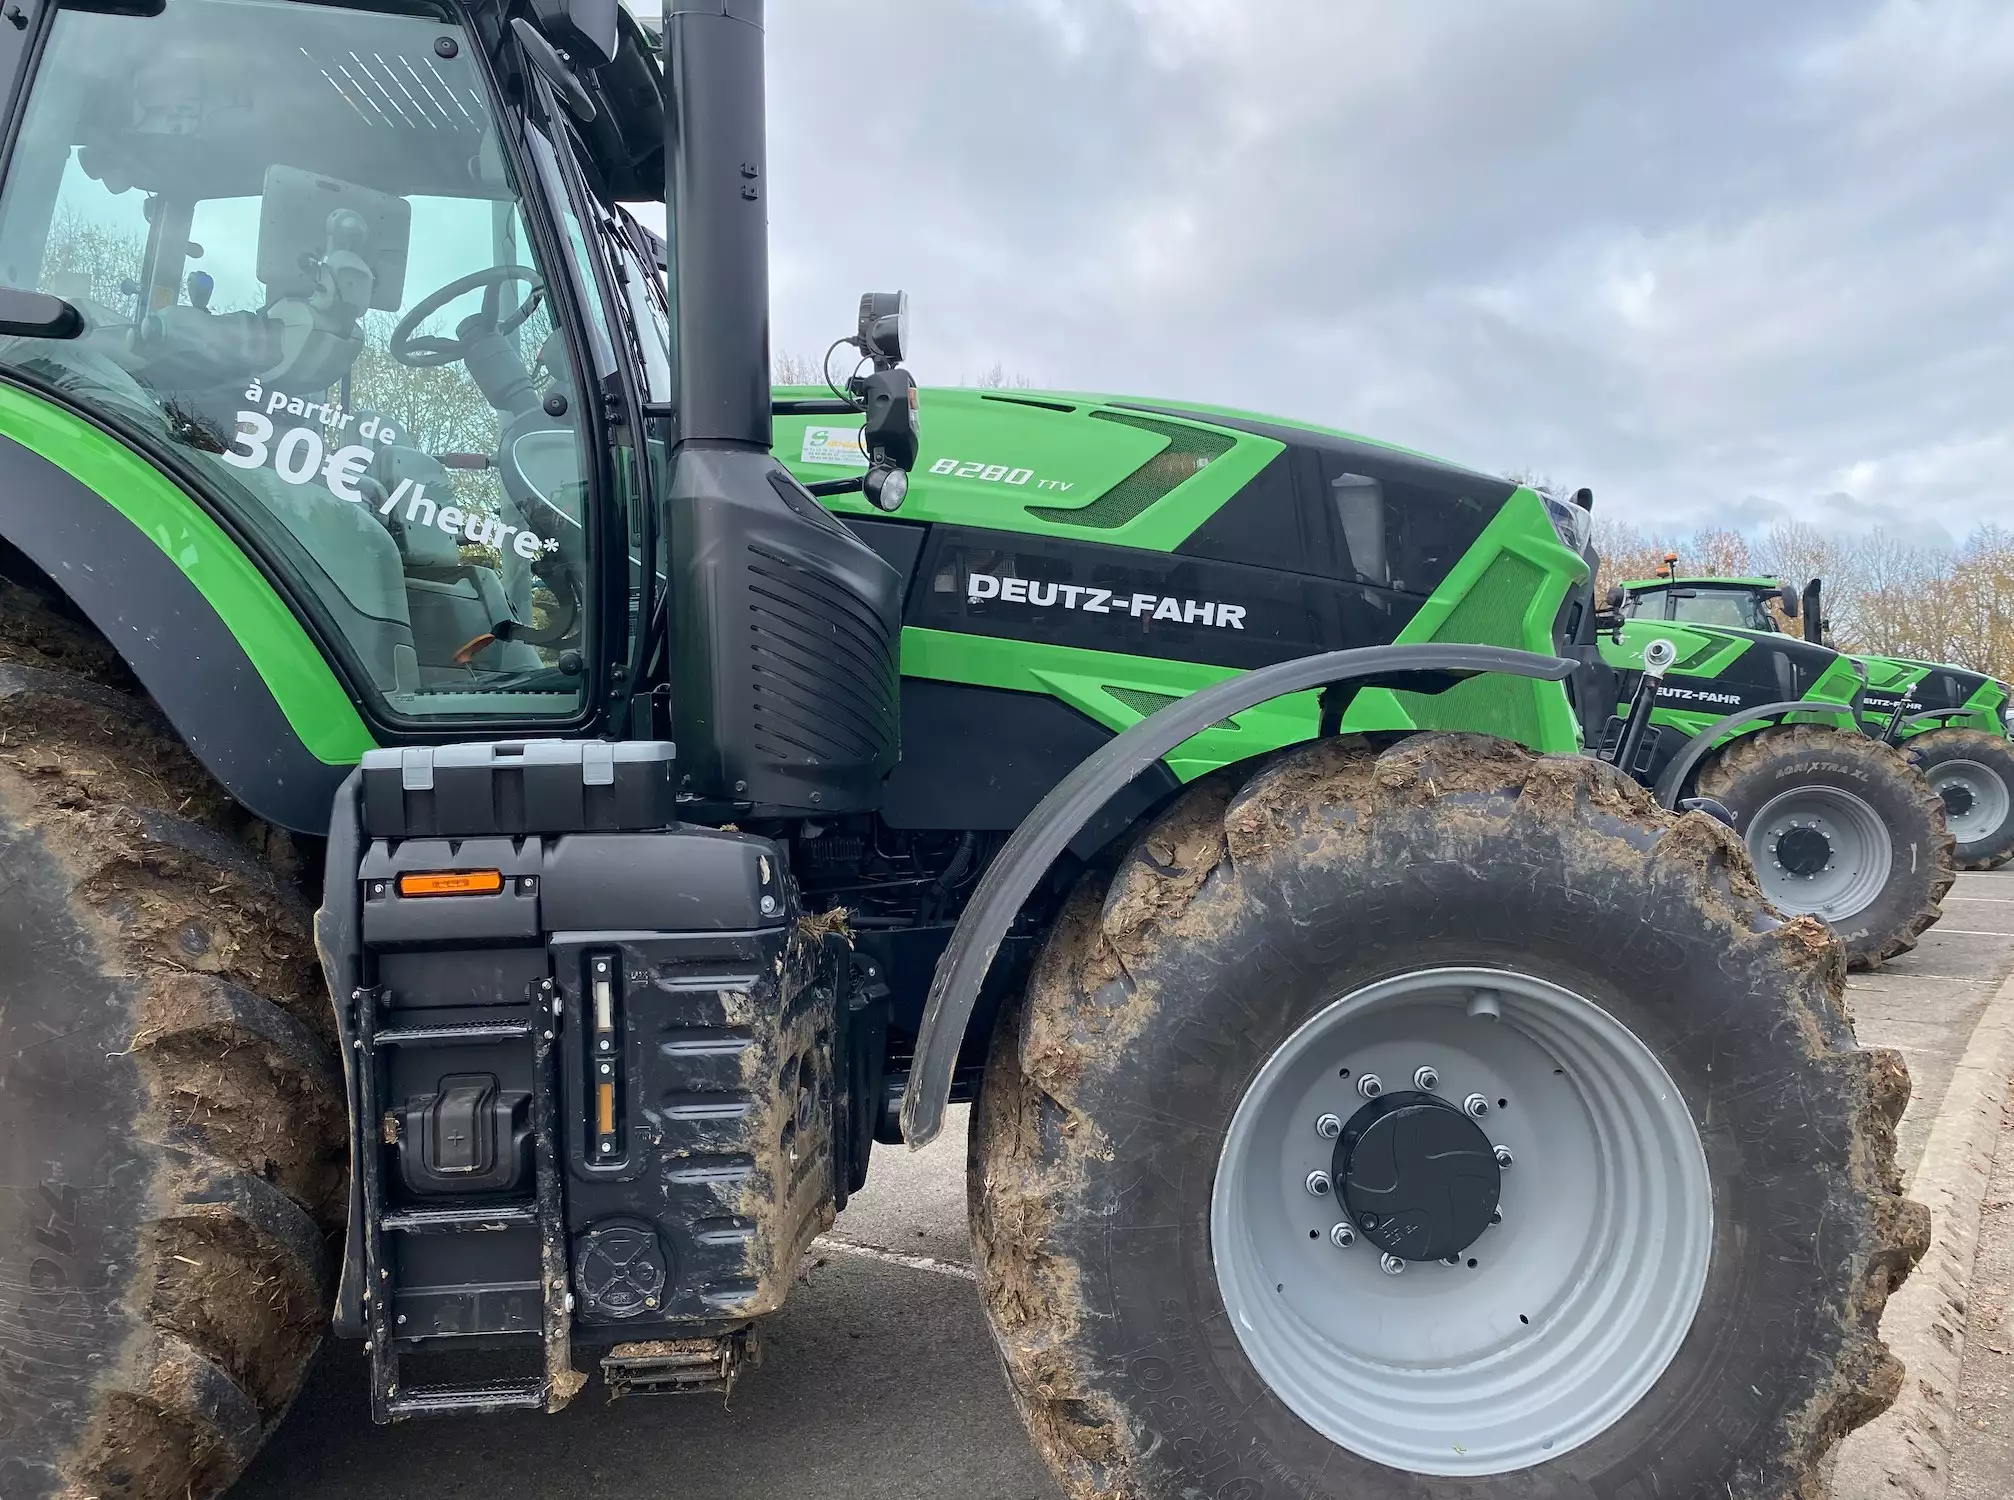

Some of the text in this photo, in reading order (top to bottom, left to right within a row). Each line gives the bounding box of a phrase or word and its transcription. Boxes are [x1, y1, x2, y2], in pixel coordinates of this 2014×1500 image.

[244, 377, 396, 445] à partir de
[222, 411, 375, 502] 30€
[928, 458, 1074, 491] 8280 TTV
[967, 573, 1247, 629] DEUTZ-FAHR
[1656, 687, 1741, 705] EUTZ-FAHR
[1863, 697, 1922, 710] EUTZ-FHR
[1775, 762, 1869, 782] AGRIXTRA XL
